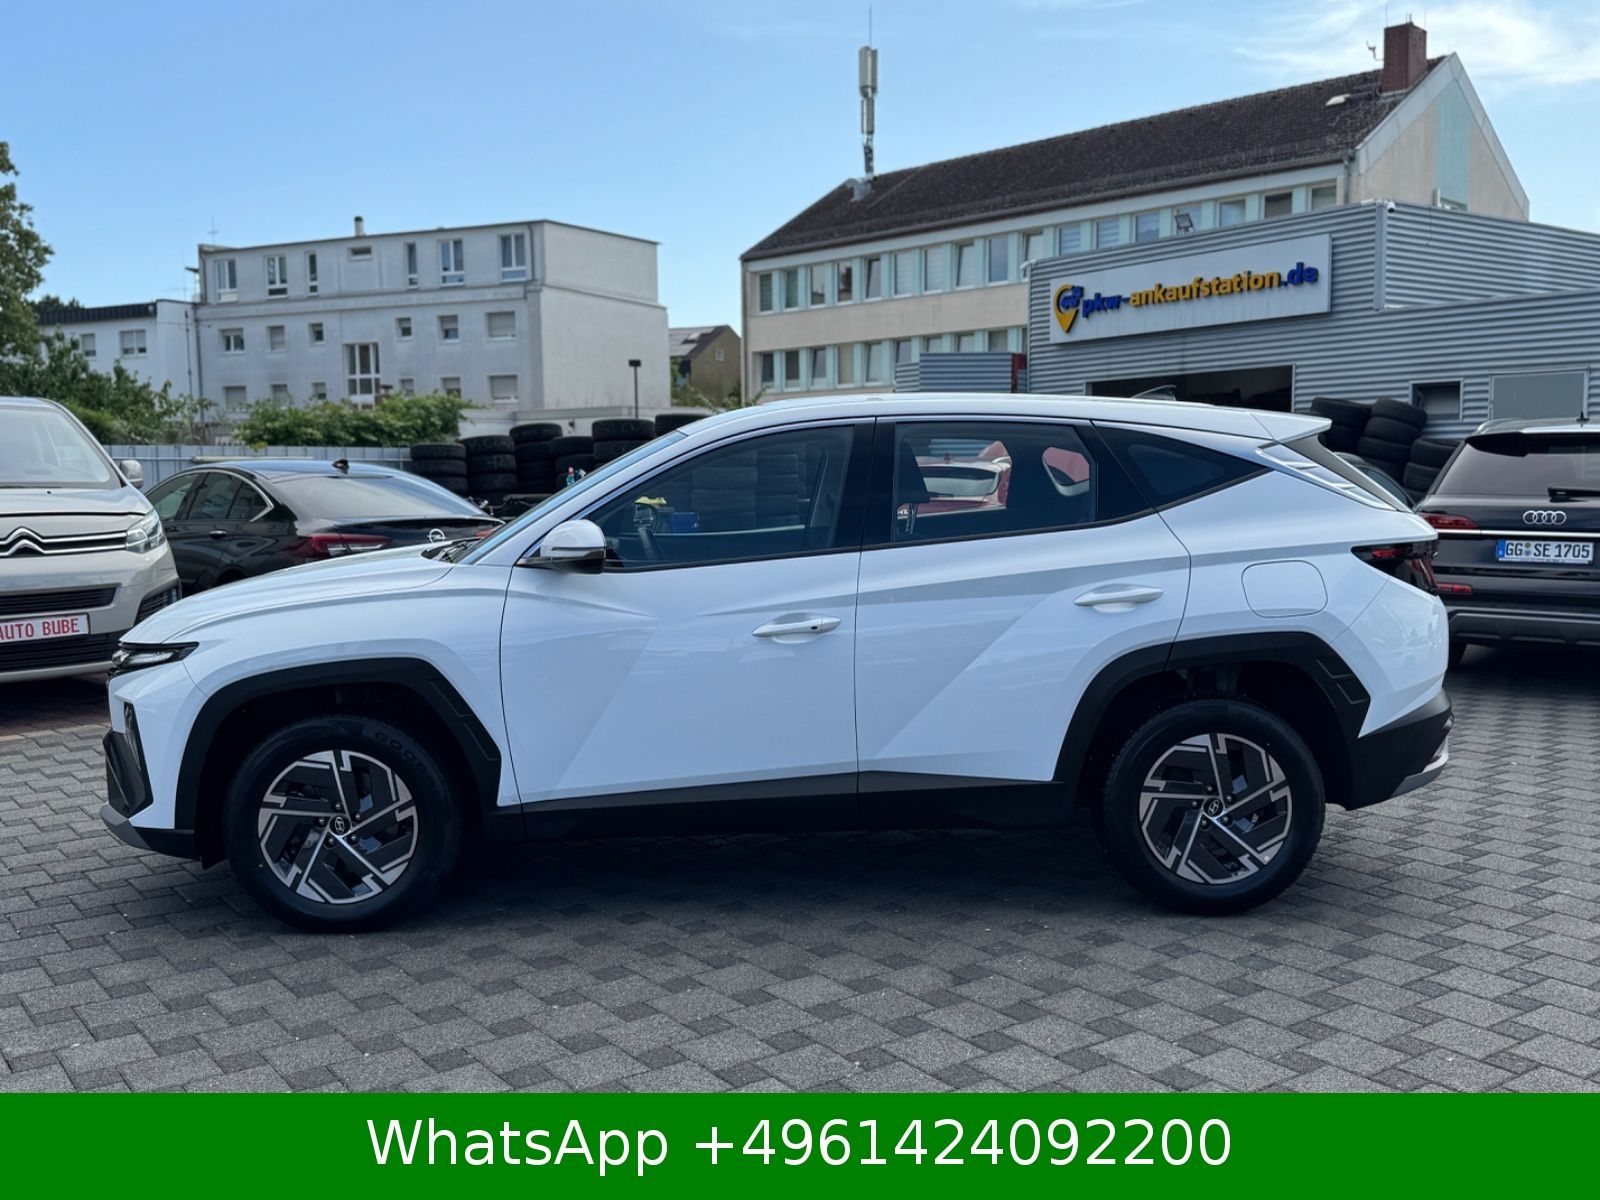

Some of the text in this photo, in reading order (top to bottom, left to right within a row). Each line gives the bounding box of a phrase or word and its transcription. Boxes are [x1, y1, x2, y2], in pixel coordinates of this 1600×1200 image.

[1081, 262, 1319, 317] pkw-ankaufstation.de
[1506, 542, 1590, 558] GG SE 1705
[42, 618, 79, 636] BUBE
